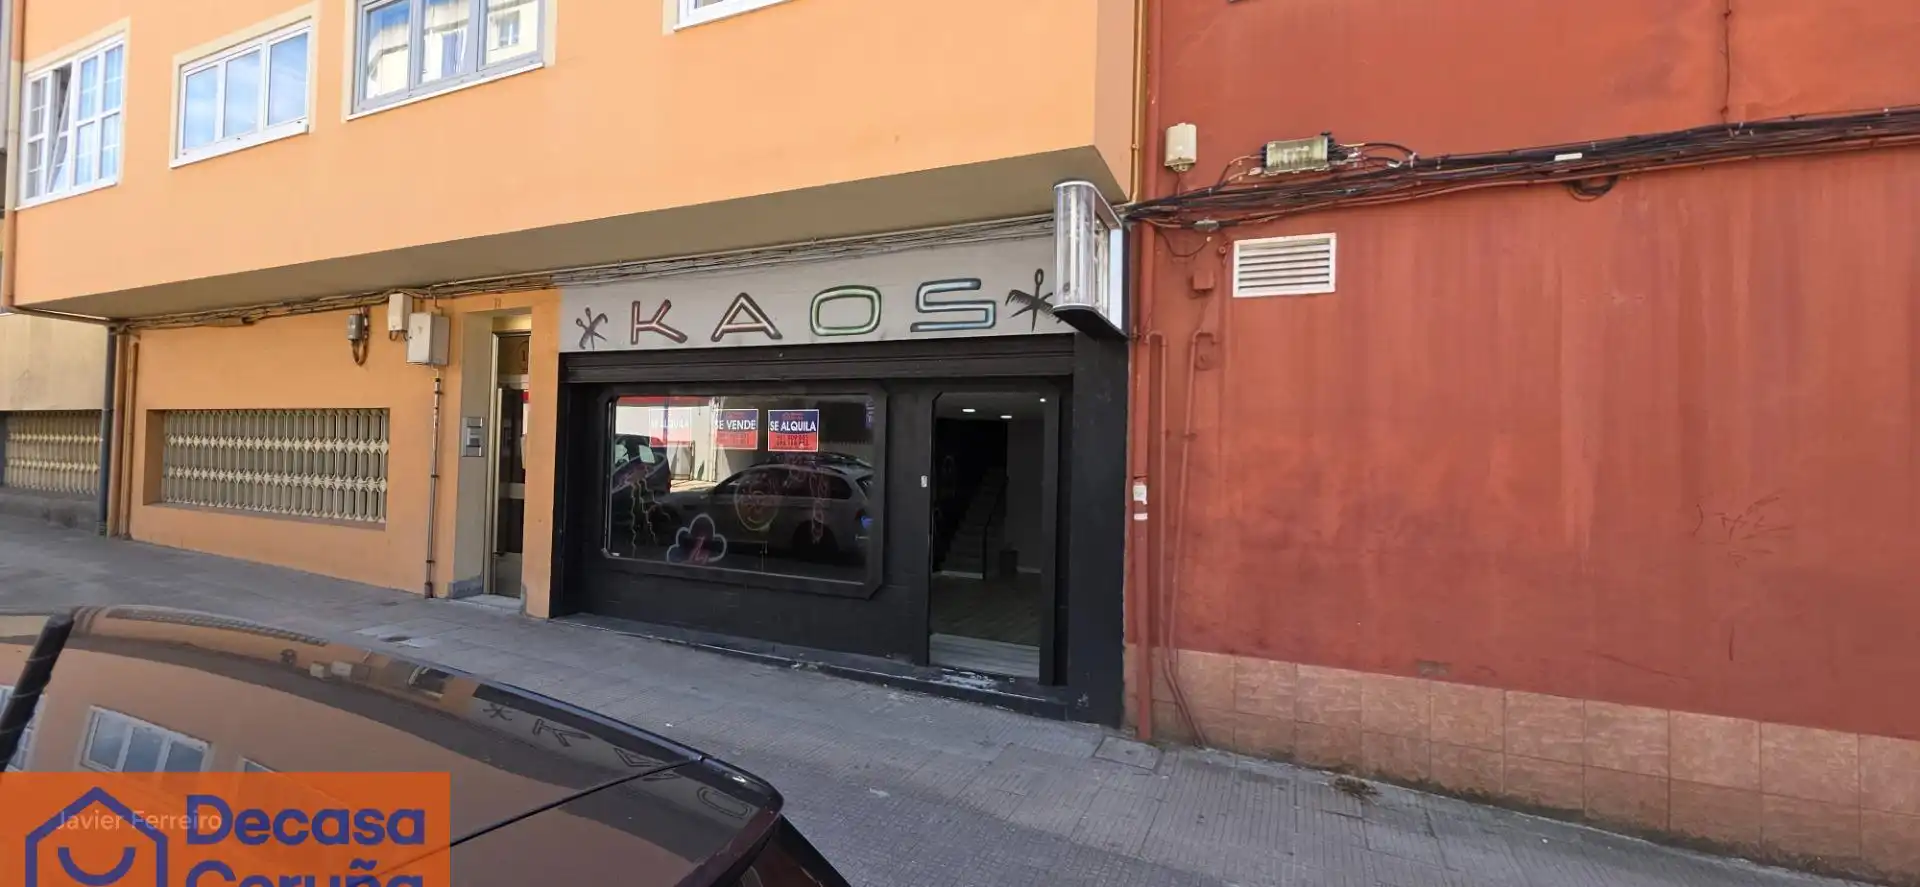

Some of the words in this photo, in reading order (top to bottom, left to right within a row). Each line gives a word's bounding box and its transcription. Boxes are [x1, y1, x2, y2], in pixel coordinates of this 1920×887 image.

[631, 277, 997, 345] KAOS
[726, 419, 757, 430] VENDE
[769, 420, 779, 432] SE
[780, 420, 817, 432] ALQUILA
